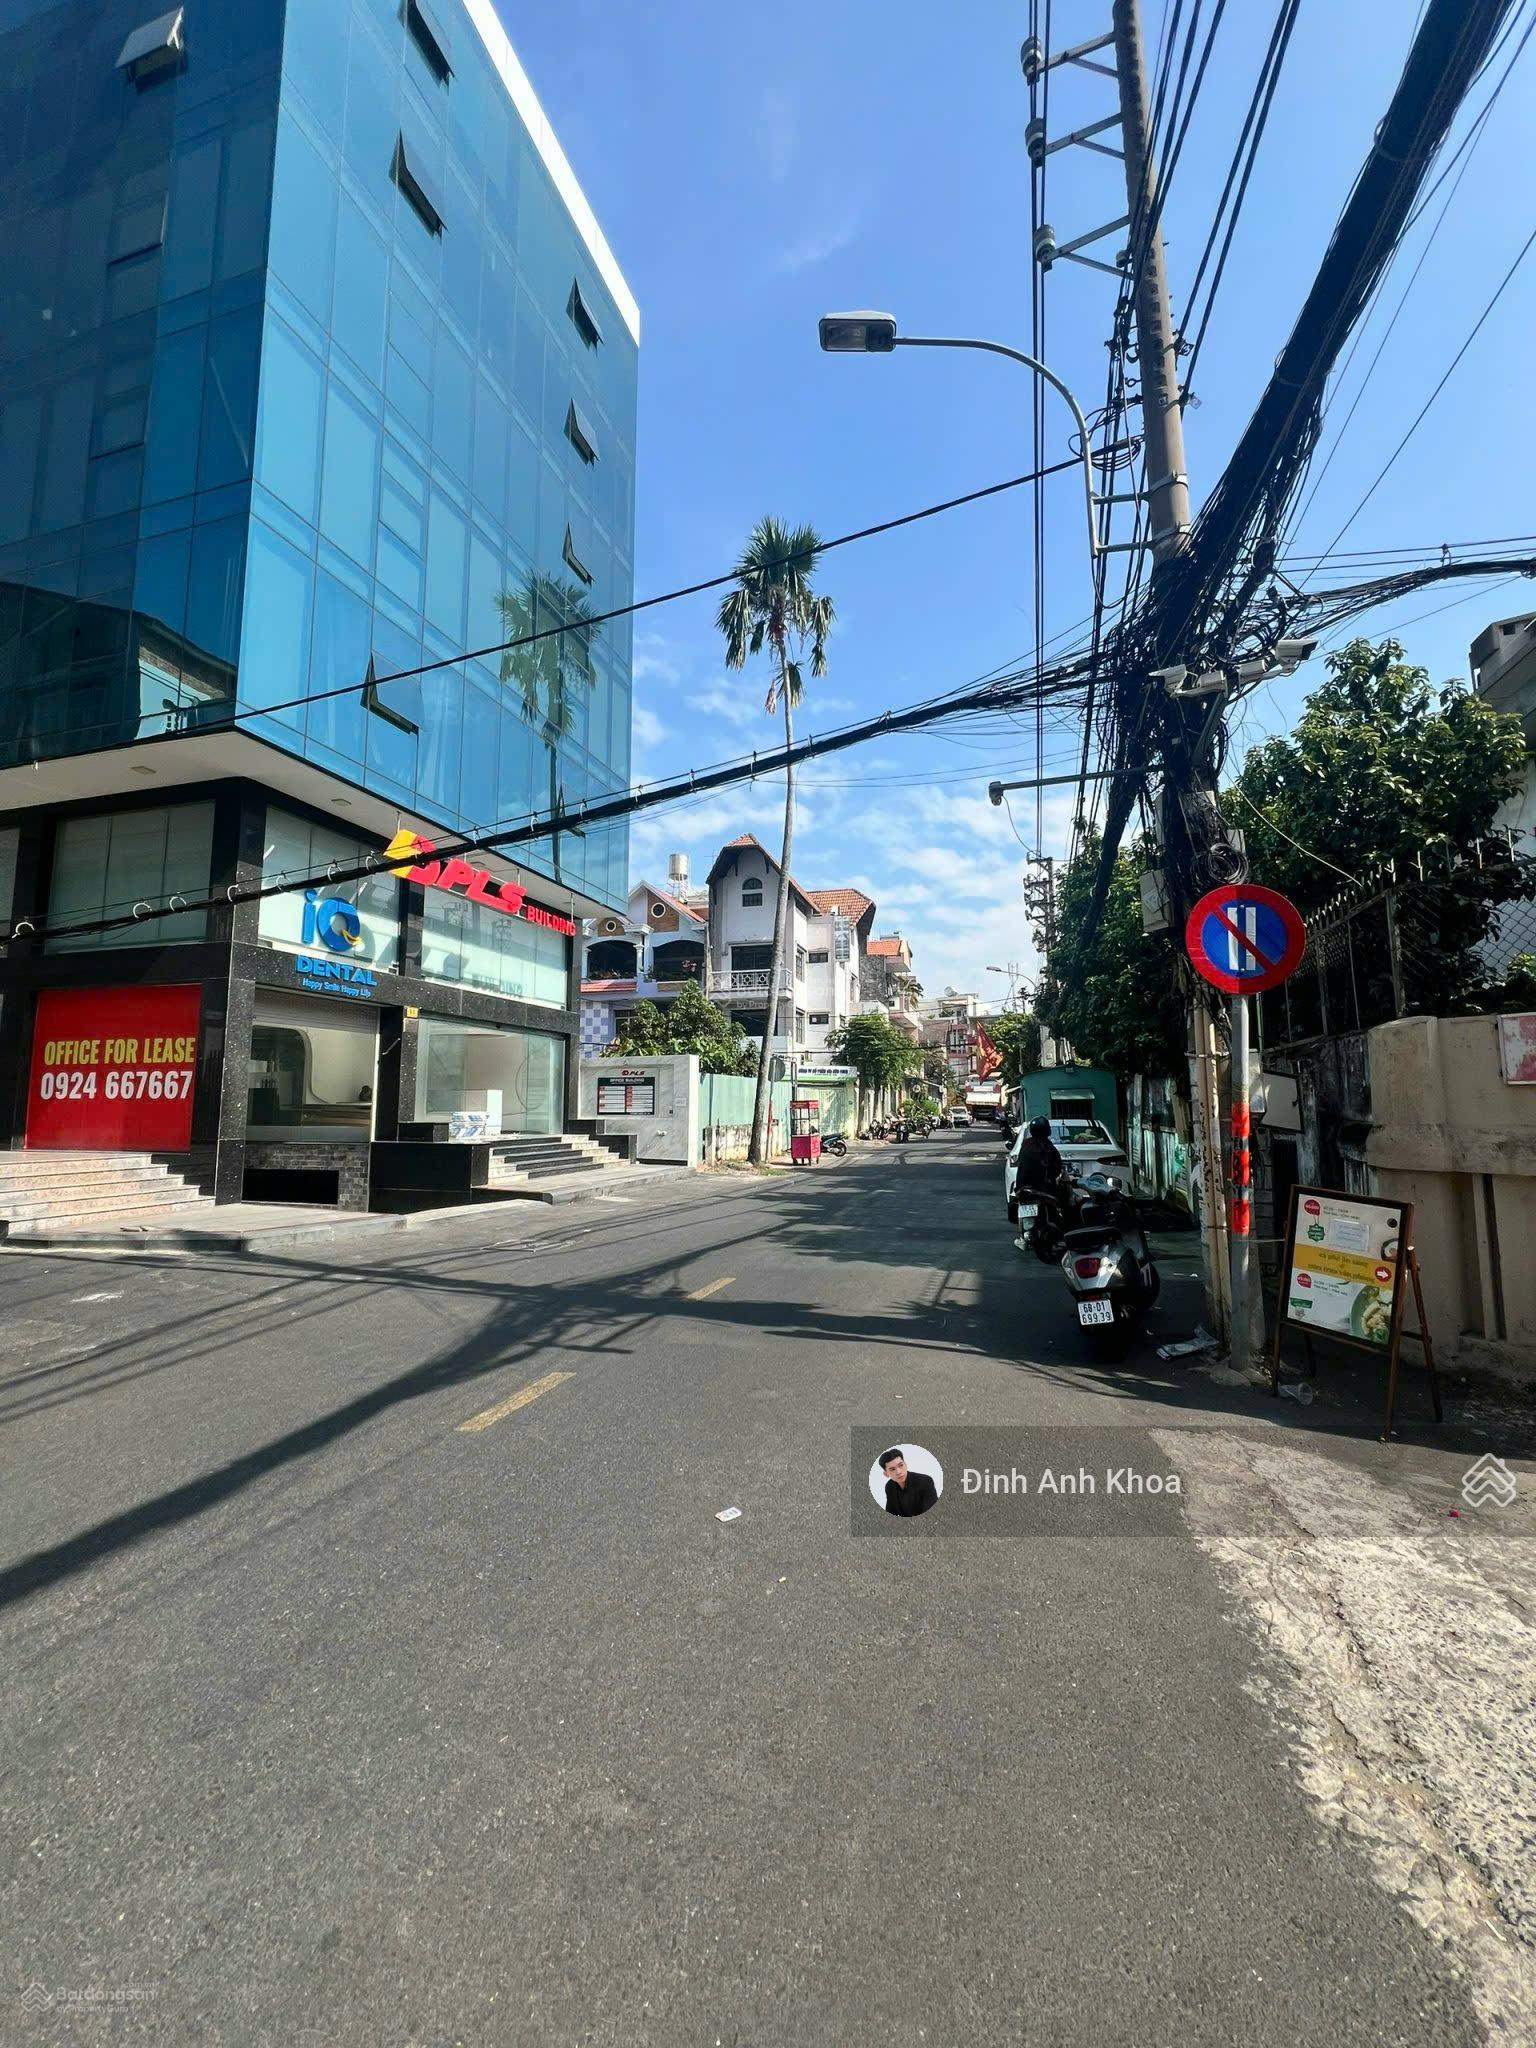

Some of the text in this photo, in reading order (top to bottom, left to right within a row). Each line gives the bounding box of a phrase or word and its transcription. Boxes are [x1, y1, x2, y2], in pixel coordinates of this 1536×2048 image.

[526, 904, 577, 937] BUILDING
[295, 954, 378, 987] DENTAL
[44, 1037, 196, 1066] OFFICE FOR LEASE
[40, 1070, 193, 1100] 0924 667667
